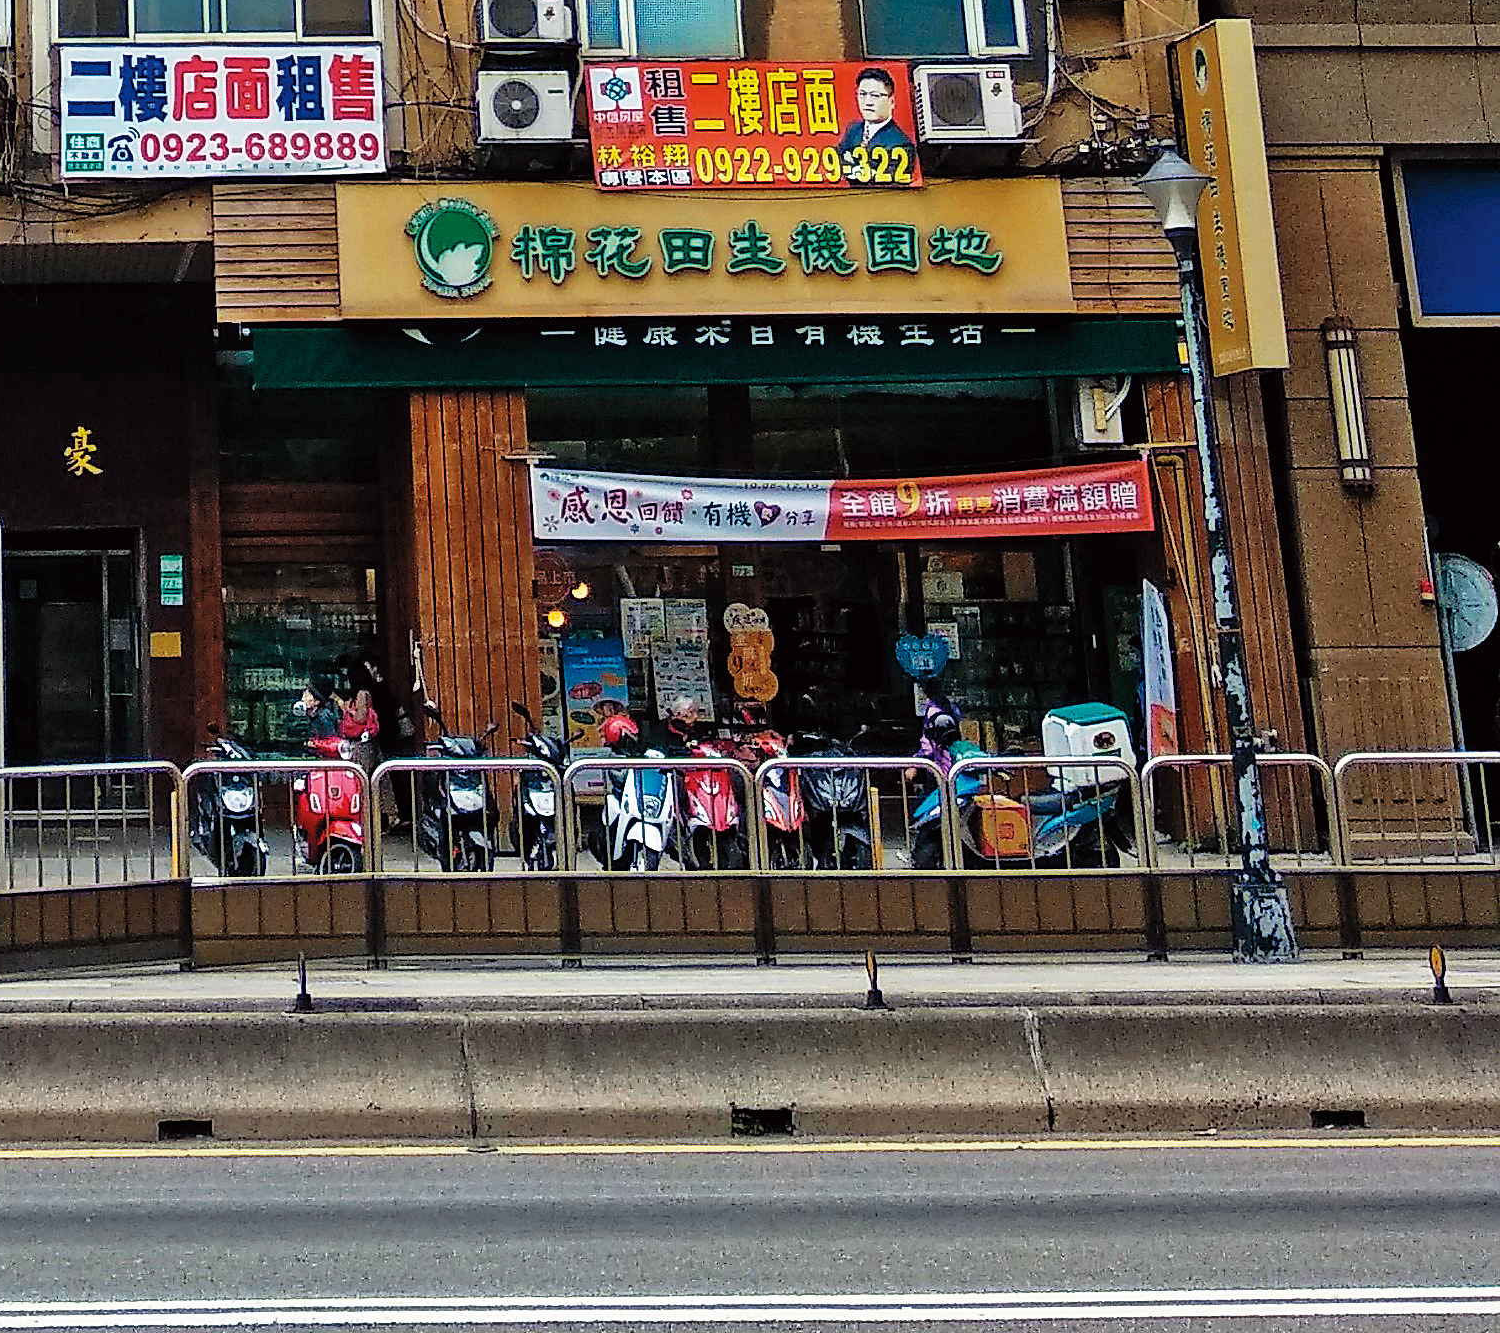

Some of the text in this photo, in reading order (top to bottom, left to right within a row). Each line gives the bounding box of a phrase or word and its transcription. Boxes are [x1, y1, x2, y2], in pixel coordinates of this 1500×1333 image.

[67, 54, 376, 122] 二樓店面租售
[690, 66, 840, 136] 二樓店面
[140, 132, 380, 163] 0923-689889
[597, 143, 690, 169] 林裕翔
[694, 145, 912, 185] 0922-929-322
[510, 219, 1003, 284] 棉花田生機園地
